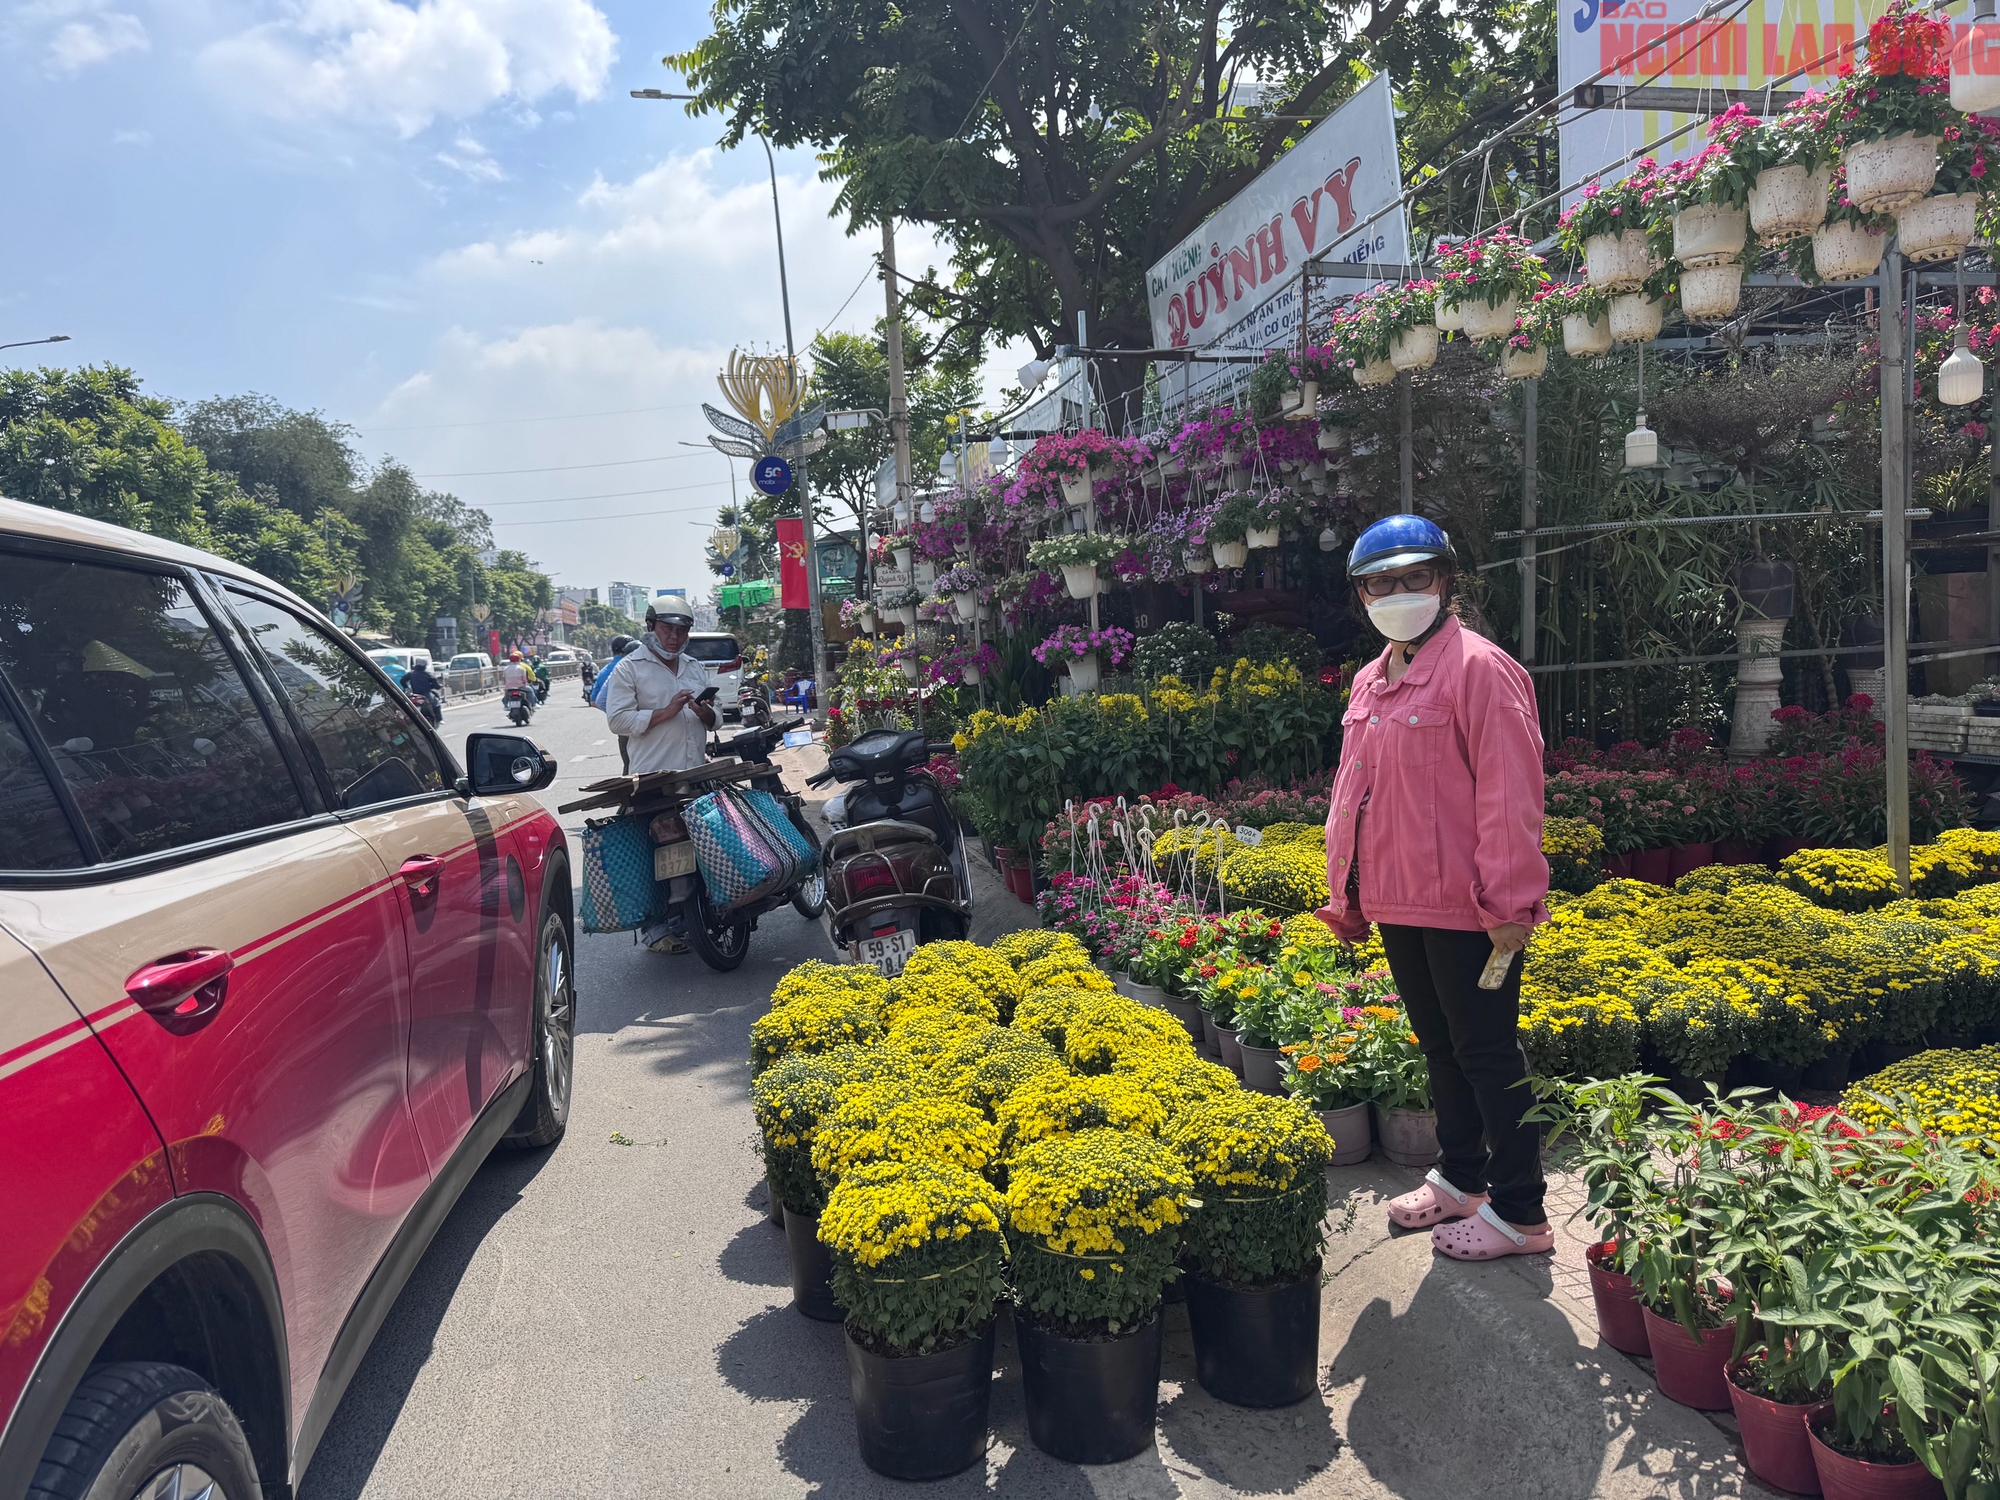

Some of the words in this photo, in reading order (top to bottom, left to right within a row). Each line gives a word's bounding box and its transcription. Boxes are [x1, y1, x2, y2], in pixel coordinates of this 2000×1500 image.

[1291, 156, 1361, 254] VY
[764, 467, 782, 478] 5G
[1135, 613, 1149, 629] 58
